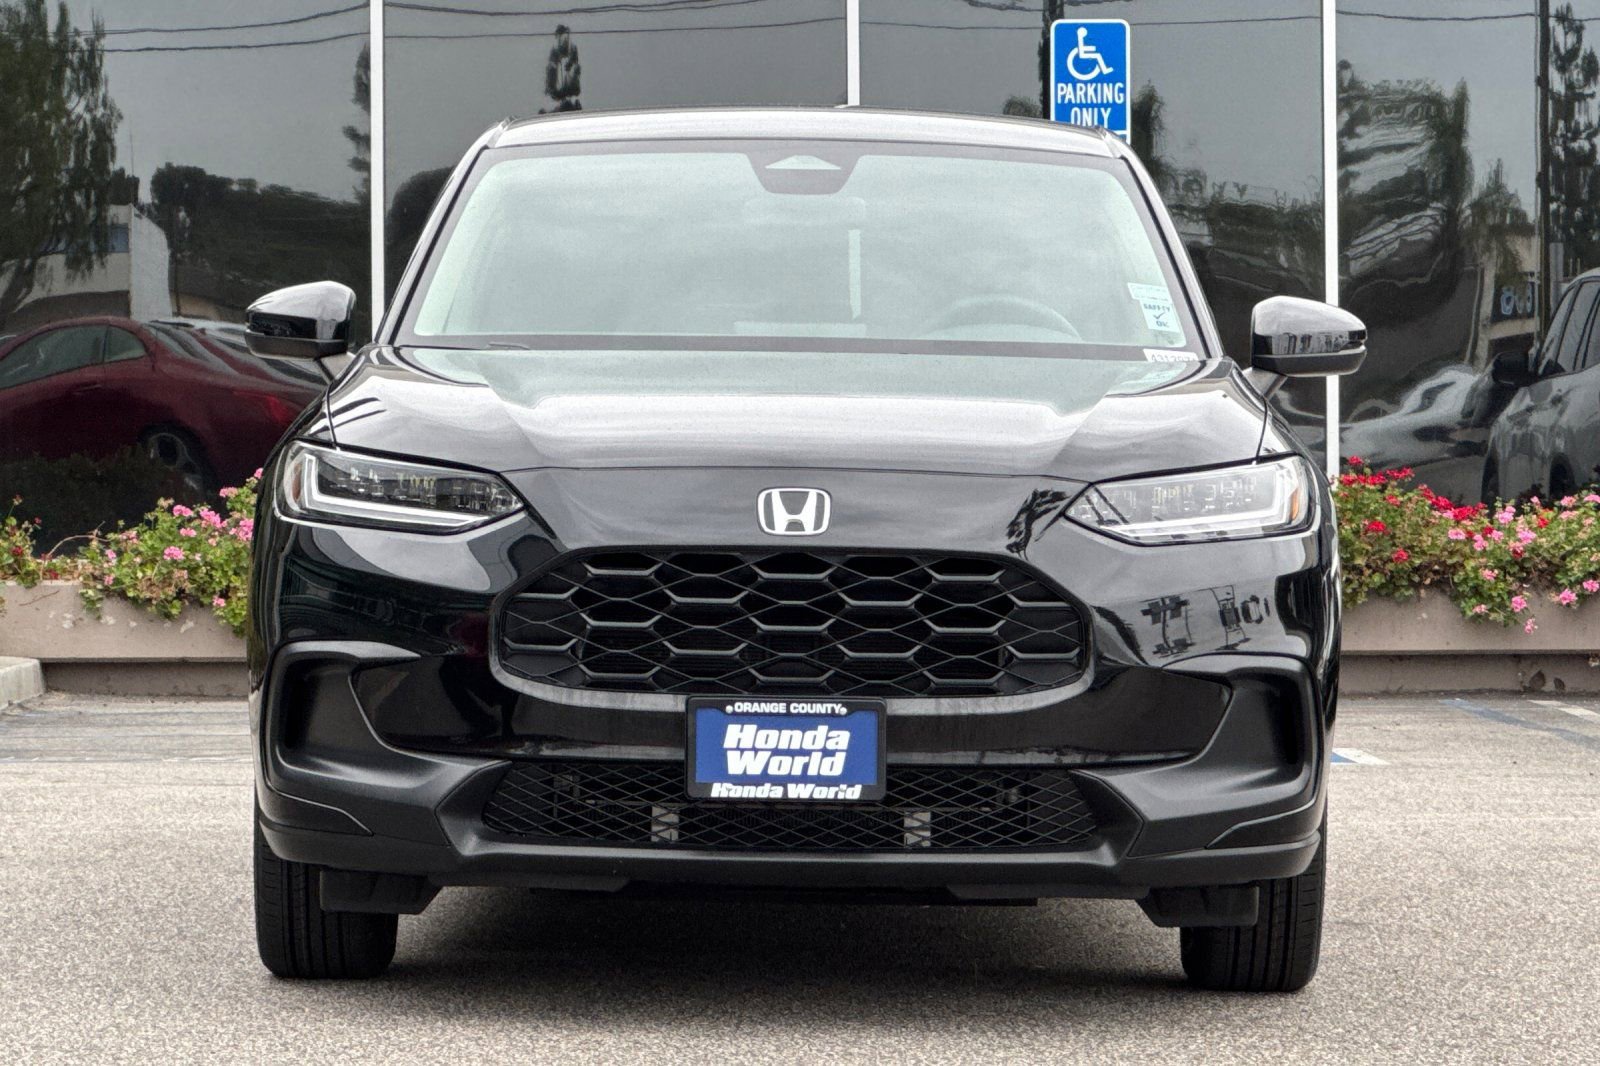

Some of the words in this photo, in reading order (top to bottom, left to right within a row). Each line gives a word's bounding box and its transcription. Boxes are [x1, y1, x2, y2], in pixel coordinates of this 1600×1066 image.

[1057, 83, 1124, 104] PARKING
[1070, 107, 1112, 128] ONLY
[734, 702, 787, 714] ORANGE
[789, 703, 842, 714] COUNTY
[723, 724, 850, 750] Honda
[727, 751, 846, 776] World
[710, 782, 785, 799] Honda
[786, 783, 863, 800] World
